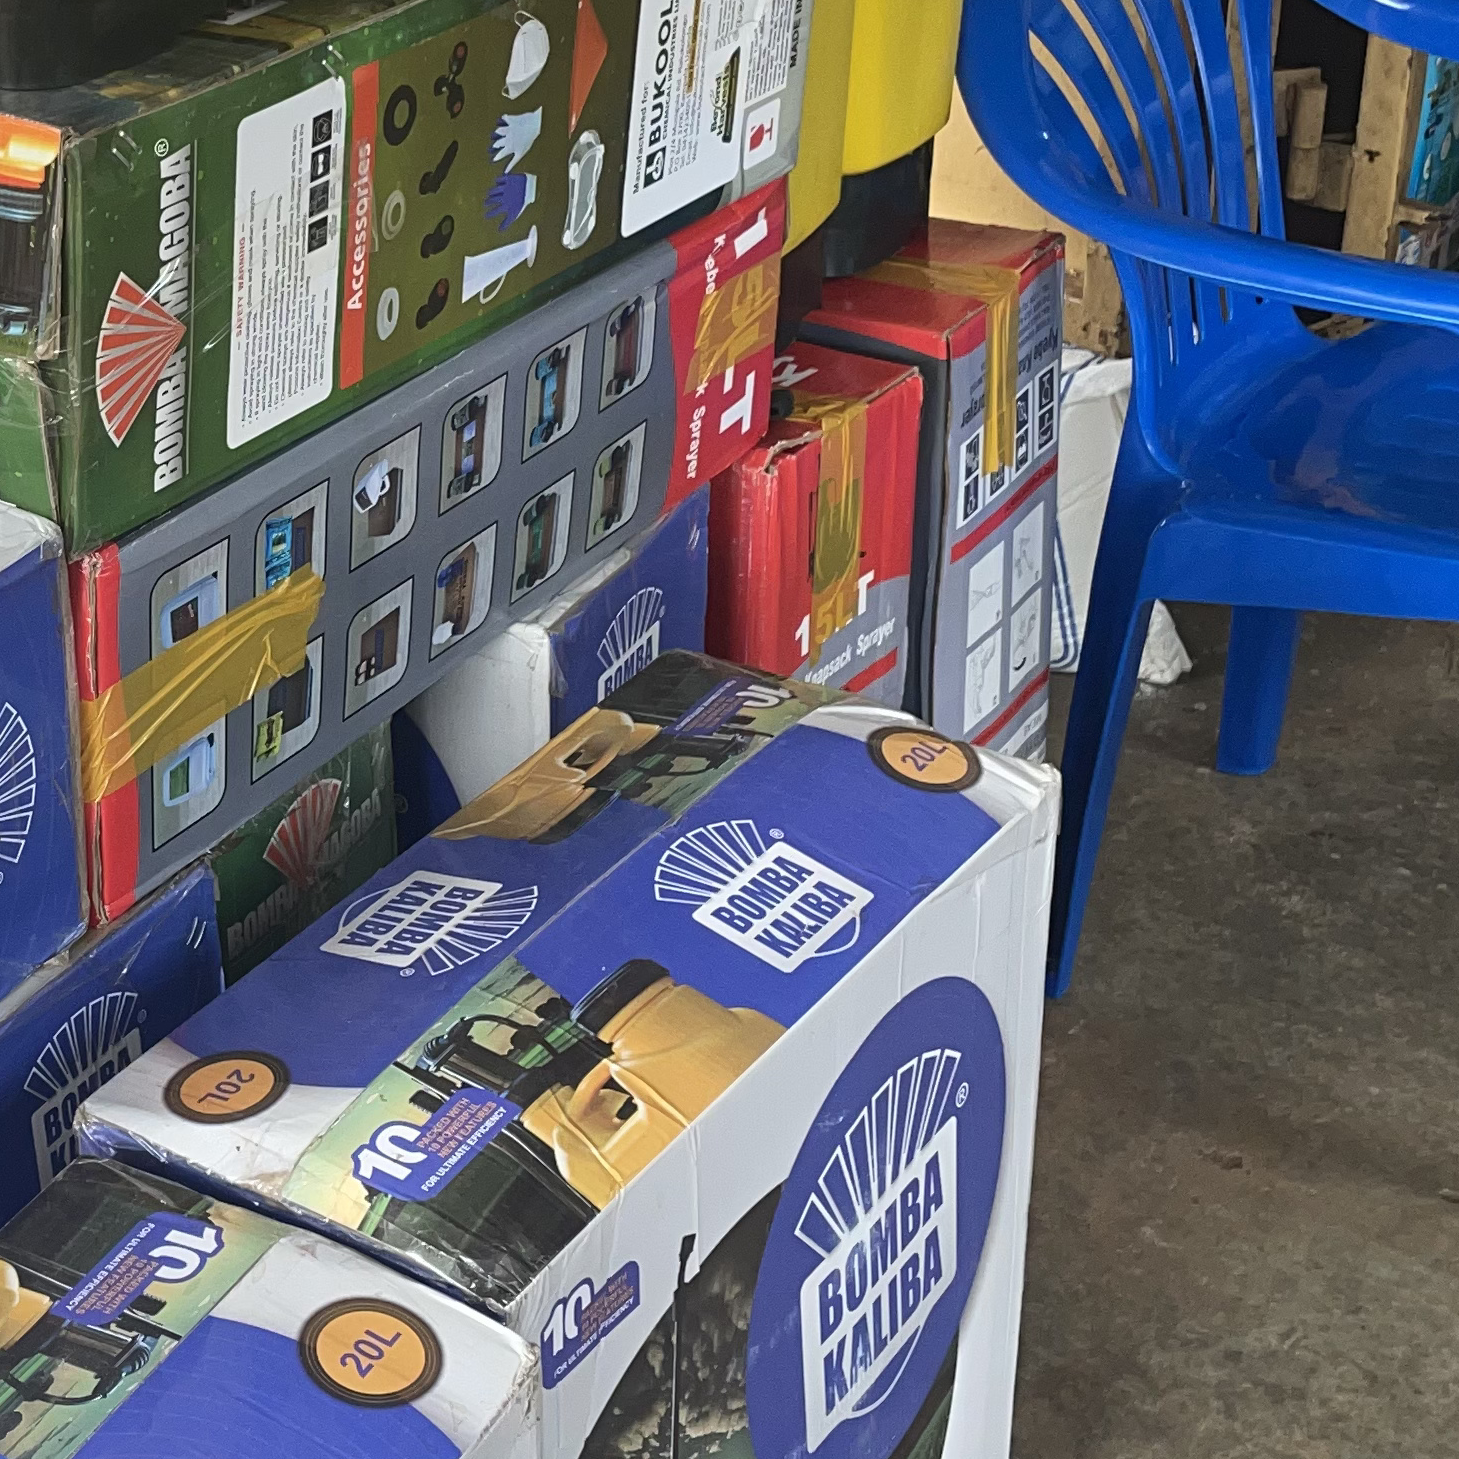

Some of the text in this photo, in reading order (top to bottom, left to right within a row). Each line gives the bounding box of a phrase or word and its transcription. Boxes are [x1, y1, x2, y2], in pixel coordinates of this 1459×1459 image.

[789, 16, 801, 68] MADE
[709, 74, 722, 133] Beyond
[716, 63, 730, 136] Harvests
[632, 105, 647, 195] Manufactured
[346, 138, 374, 311] Accessories
[153, 345, 189, 493] BOMBA
[686, 404, 707, 480] Sprayer
[900, 736, 950, 772] 20L
[337, 879, 446, 948] KALIBA
[375, 886, 485, 956] BOMBA
[711, 854, 816, 933] BOMBA
[754, 880, 857, 959] KALIBA
[197, 1068, 255, 1105] 20L
[420, 1105, 508, 1193] FOR ULTIMATE EFFICIENCY
[65, 1222, 156, 1312] FOR ULTIMATE EFFICIENCY
[818, 1150, 944, 1346] BOMBA
[339, 1327, 403, 1380] 20L
[823, 1225, 944, 1418] KALIBA
